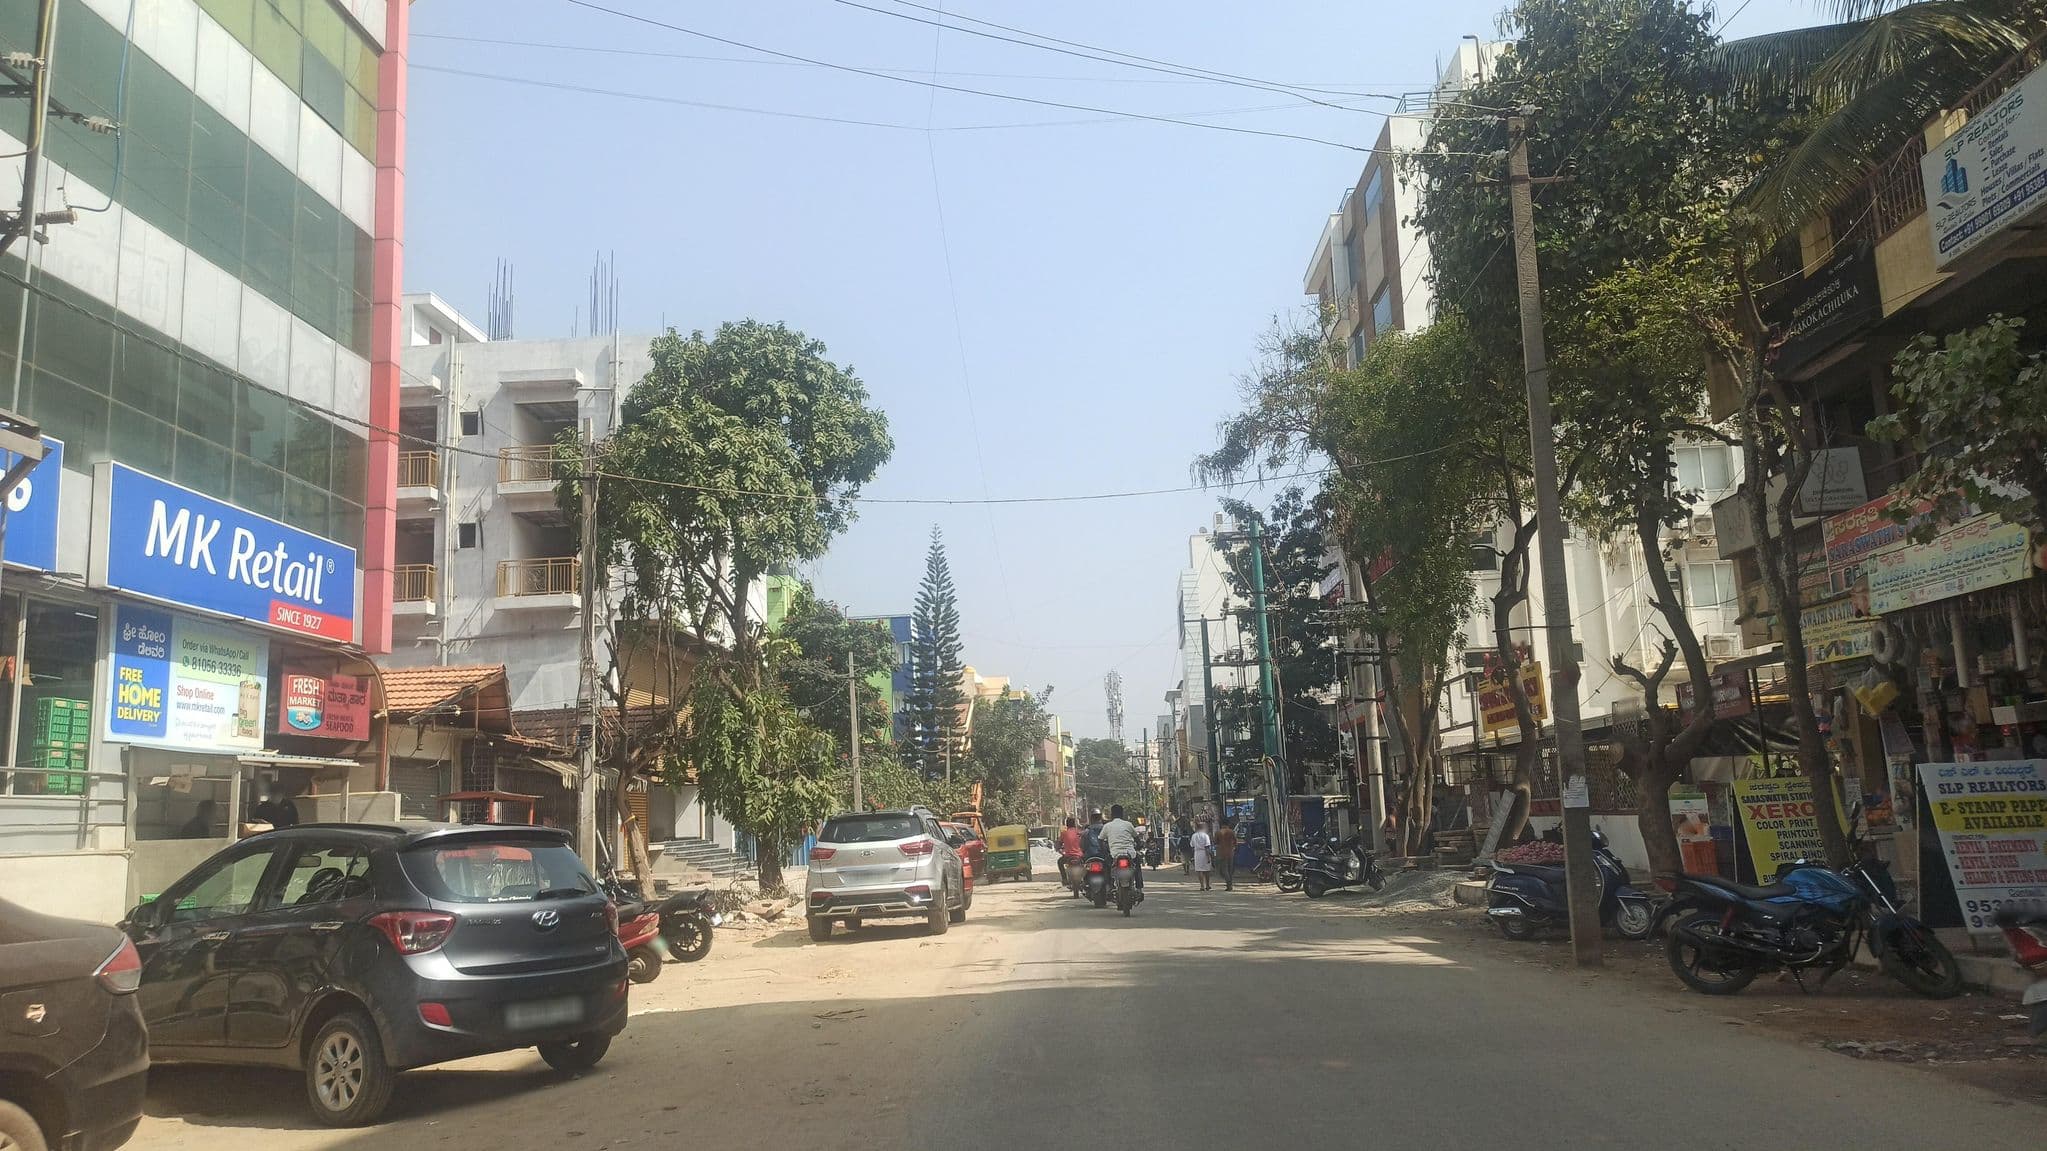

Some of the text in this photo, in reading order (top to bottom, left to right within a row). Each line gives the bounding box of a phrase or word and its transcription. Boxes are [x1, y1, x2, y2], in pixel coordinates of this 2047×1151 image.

[1944, 138, 1964, 161] SLP
[1967, 94, 2024, 144] REALTORS
[1978, 124, 2004, 146] Contact
[1990, 146, 2016, 167] Purchase
[2001, 163, 2040, 193] Commercials
[144, 498, 220, 576] MK
[276, 606, 322, 630] SINCE 1927
[182, 639, 199, 650] Order
[200, 643, 208, 652] via
[119, 667, 144, 683] FREE
[192, 657, 241, 677] 81056 33336
[177, 685, 214, 700] Shop Online
[293, 678, 319, 695] FRESH
[119, 684, 162, 708] HOME
[289, 696, 321, 707] MARKET
[117, 706, 160, 723] DELIVERY
[326, 721, 354, 733] SEAFOOD
[1938, 780, 2046, 794] SLP REALTORS
[1748, 802, 1817, 820] XERO
[1939, 799, 2047, 815] E- STAMP PAPE
[1756, 819, 1814, 830] COLOR PRINT
[1963, 814, 2044, 830] AVAILABLE
[1777, 829, 1819, 839] PRINTOUT
[1779, 840, 1823, 850] SCANNING
[1770, 851, 1826, 861] SPIRAL BINDI
